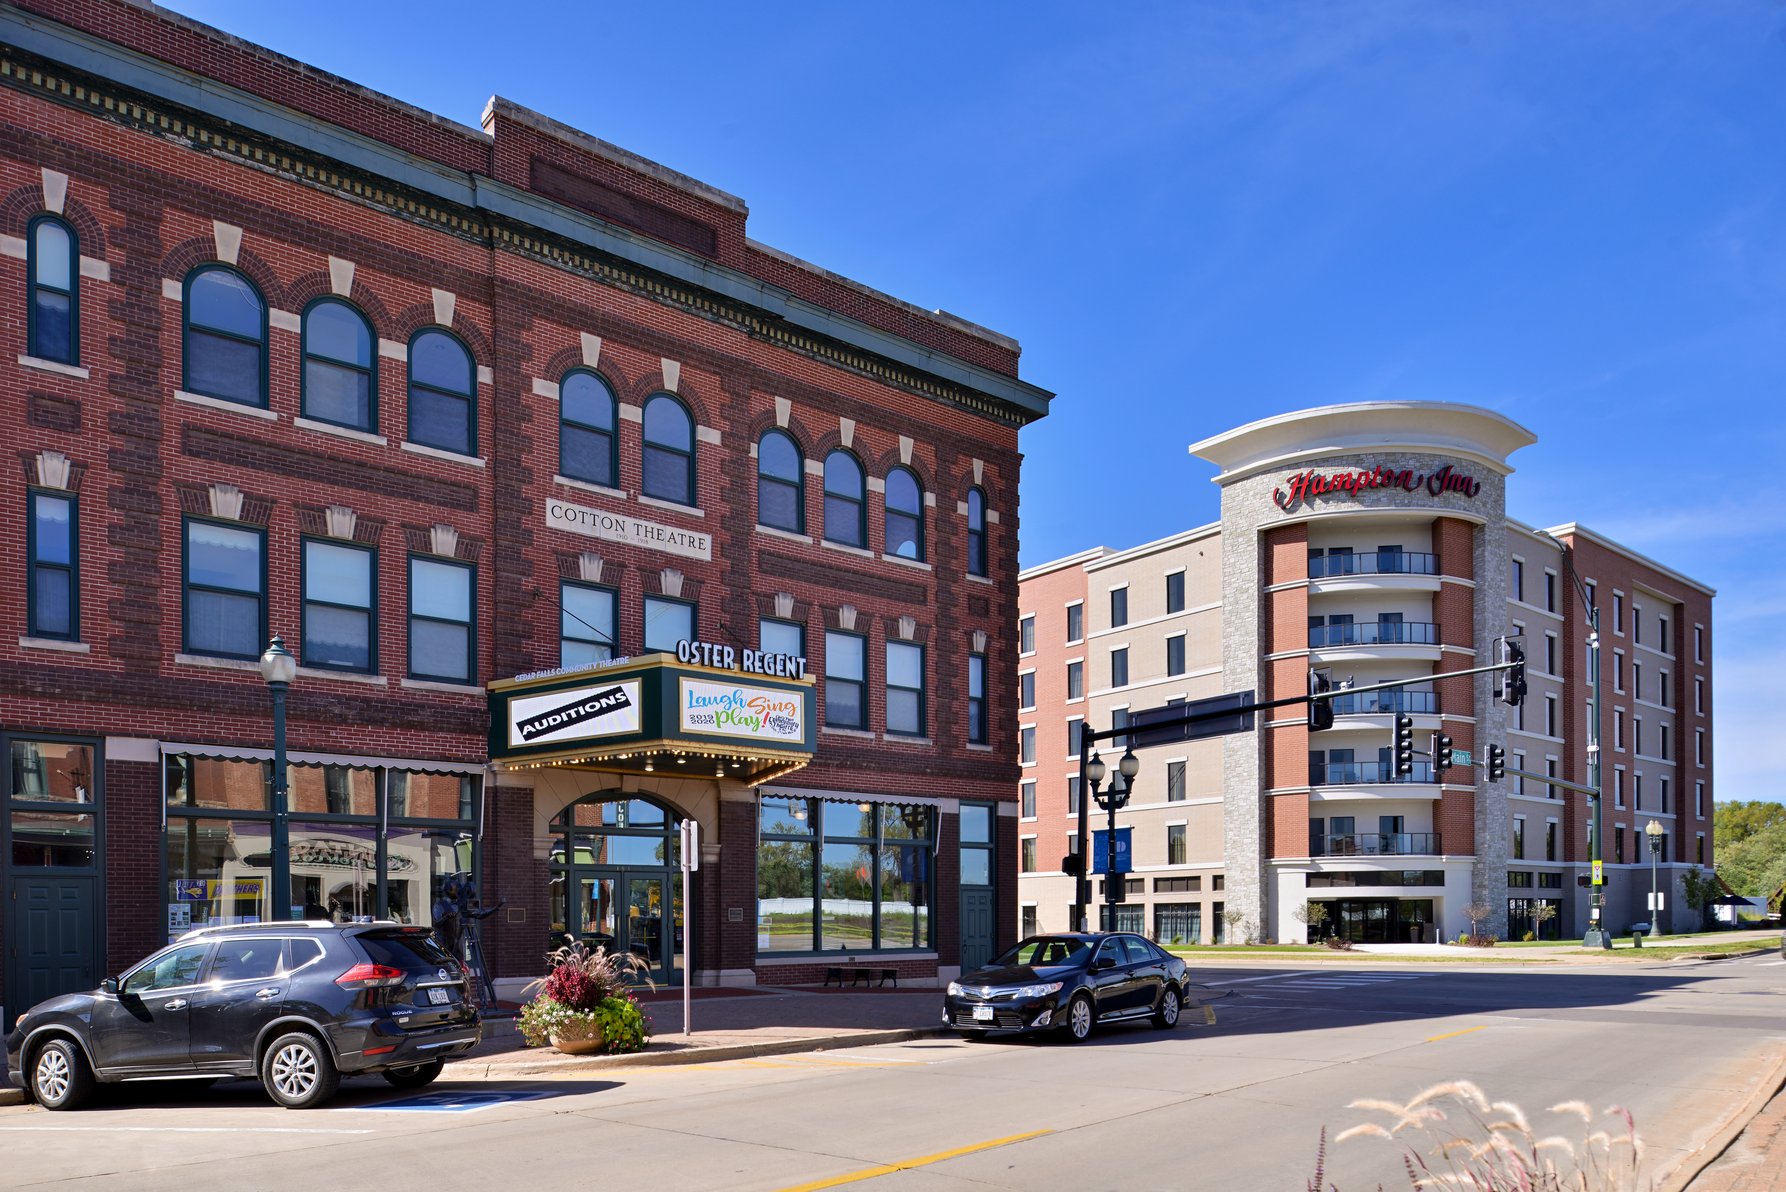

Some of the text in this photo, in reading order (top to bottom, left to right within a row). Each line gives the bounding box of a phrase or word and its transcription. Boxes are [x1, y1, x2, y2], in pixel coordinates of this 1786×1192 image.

[1273, 464, 1481, 510] Hampton Inn
[551, 505, 707, 550] COTTON THEATRE
[514, 656, 630, 682] CEDAR FALLS COMMUNITY THEATRE
[677, 639, 807, 680] OSTER REGENT
[522, 691, 627, 736] AUDITIONS
[688, 689, 798, 717] Laugh Sing
[689, 713, 714, 721] 2019
